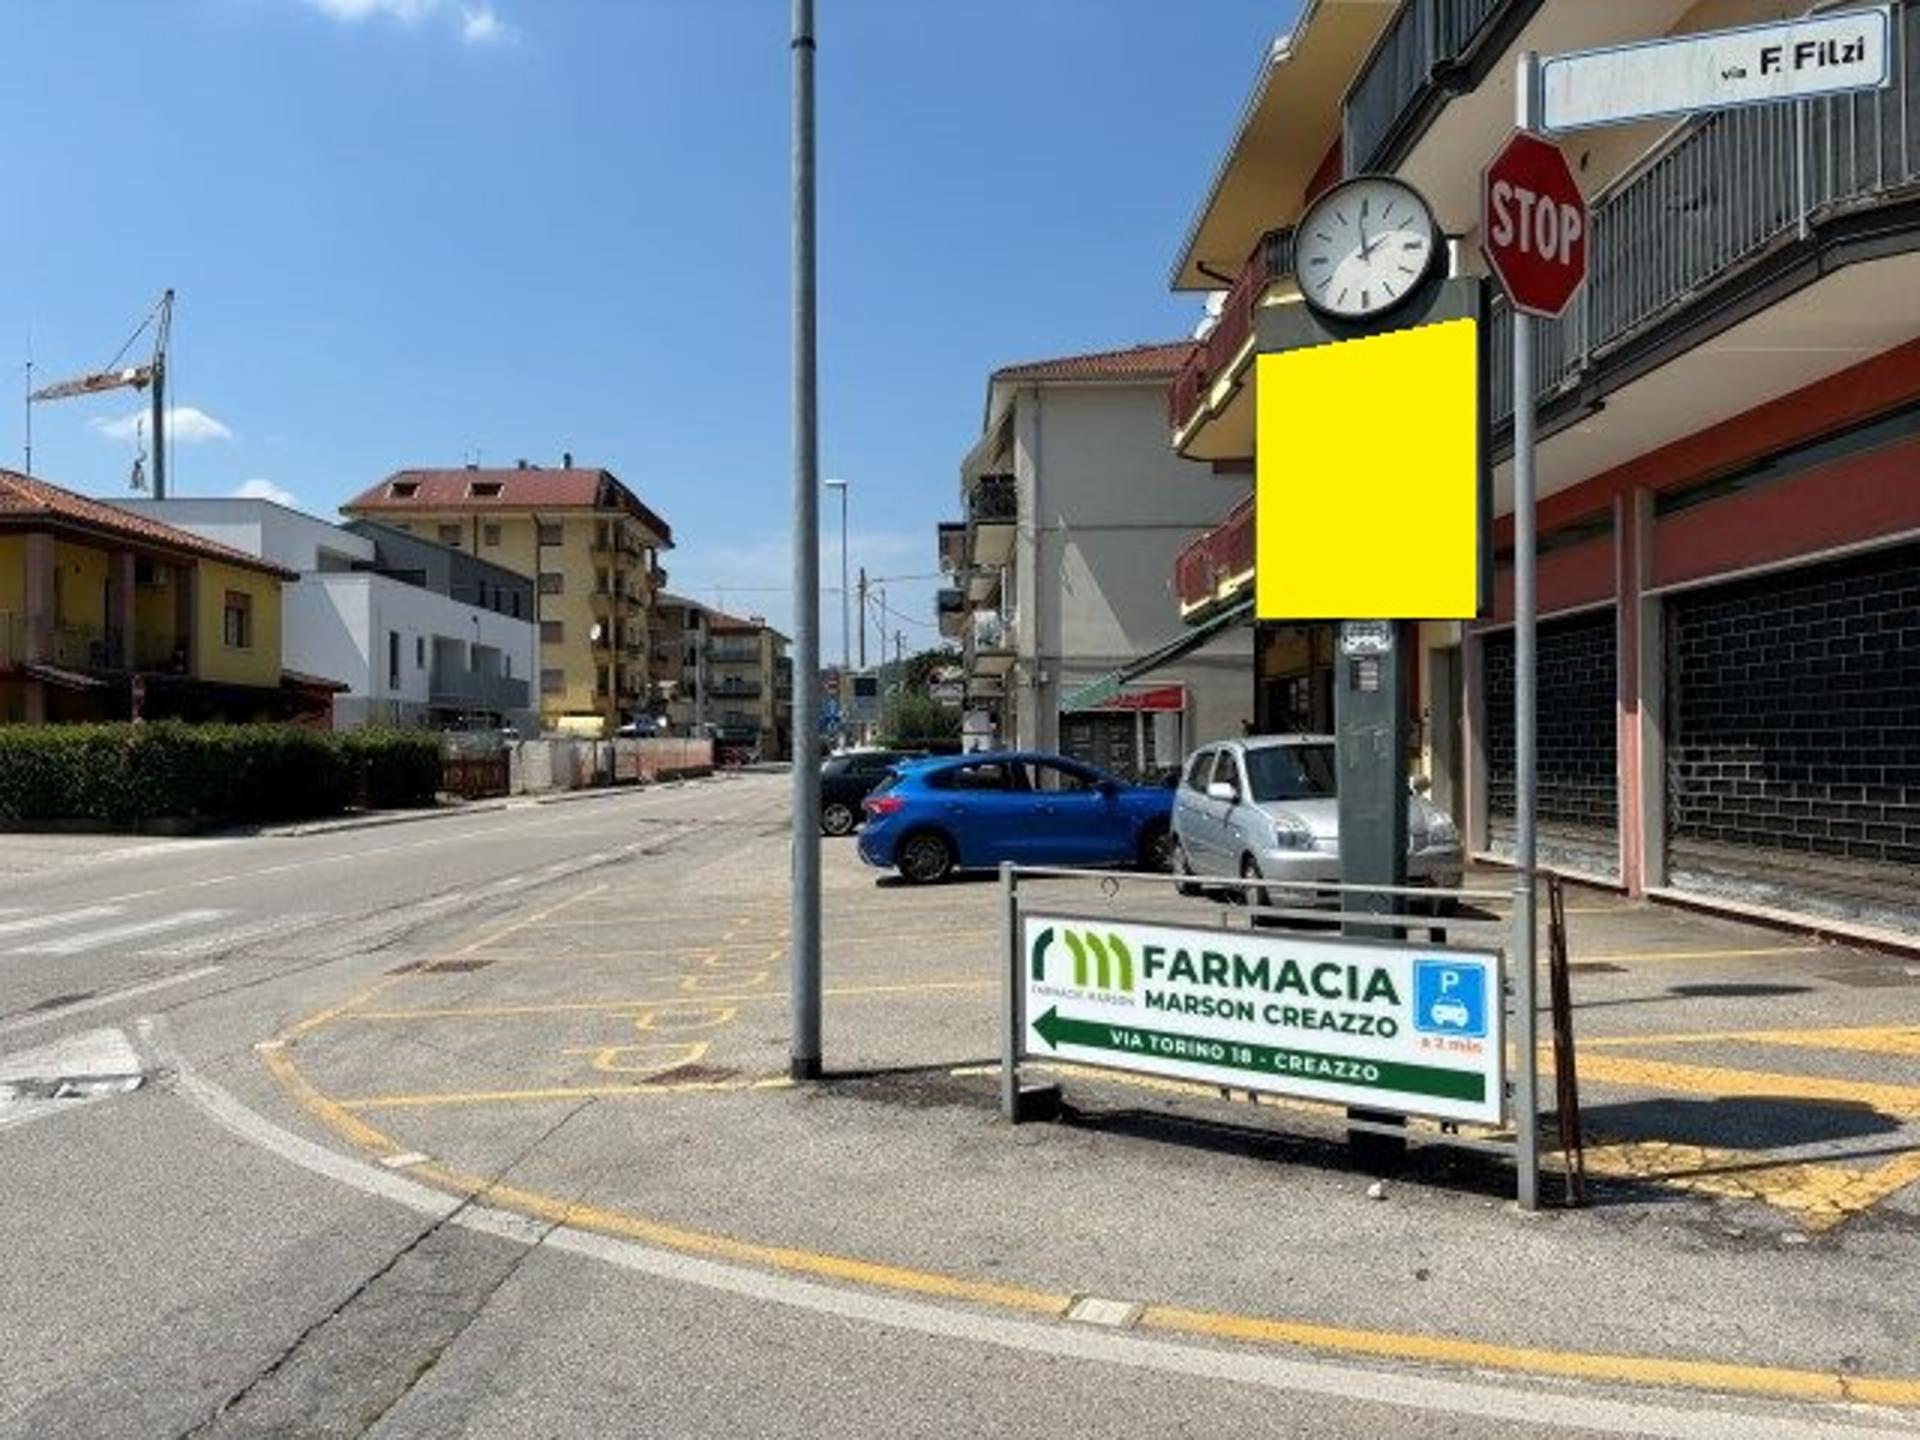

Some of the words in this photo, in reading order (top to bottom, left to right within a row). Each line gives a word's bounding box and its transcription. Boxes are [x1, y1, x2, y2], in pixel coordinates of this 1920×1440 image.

[1721, 65, 1747, 80] via
[1760, 46, 1782, 75] F.
[1794, 36, 1865, 70] Filzi
[1491, 178, 1582, 266] STOP
[1143, 945, 1402, 1006] FARMACIA
[1442, 971, 1460, 994] P
[1144, 990, 1255, 1022] MARSON
[1262, 1004, 1399, 1039] CREAZZO
[1109, 1028, 1144, 1048] VIA
[1149, 1034, 1225, 1060] TORINO
[1231, 1046, 1251, 1064] 18
[1274, 1052, 1380, 1081] CREAZZO
